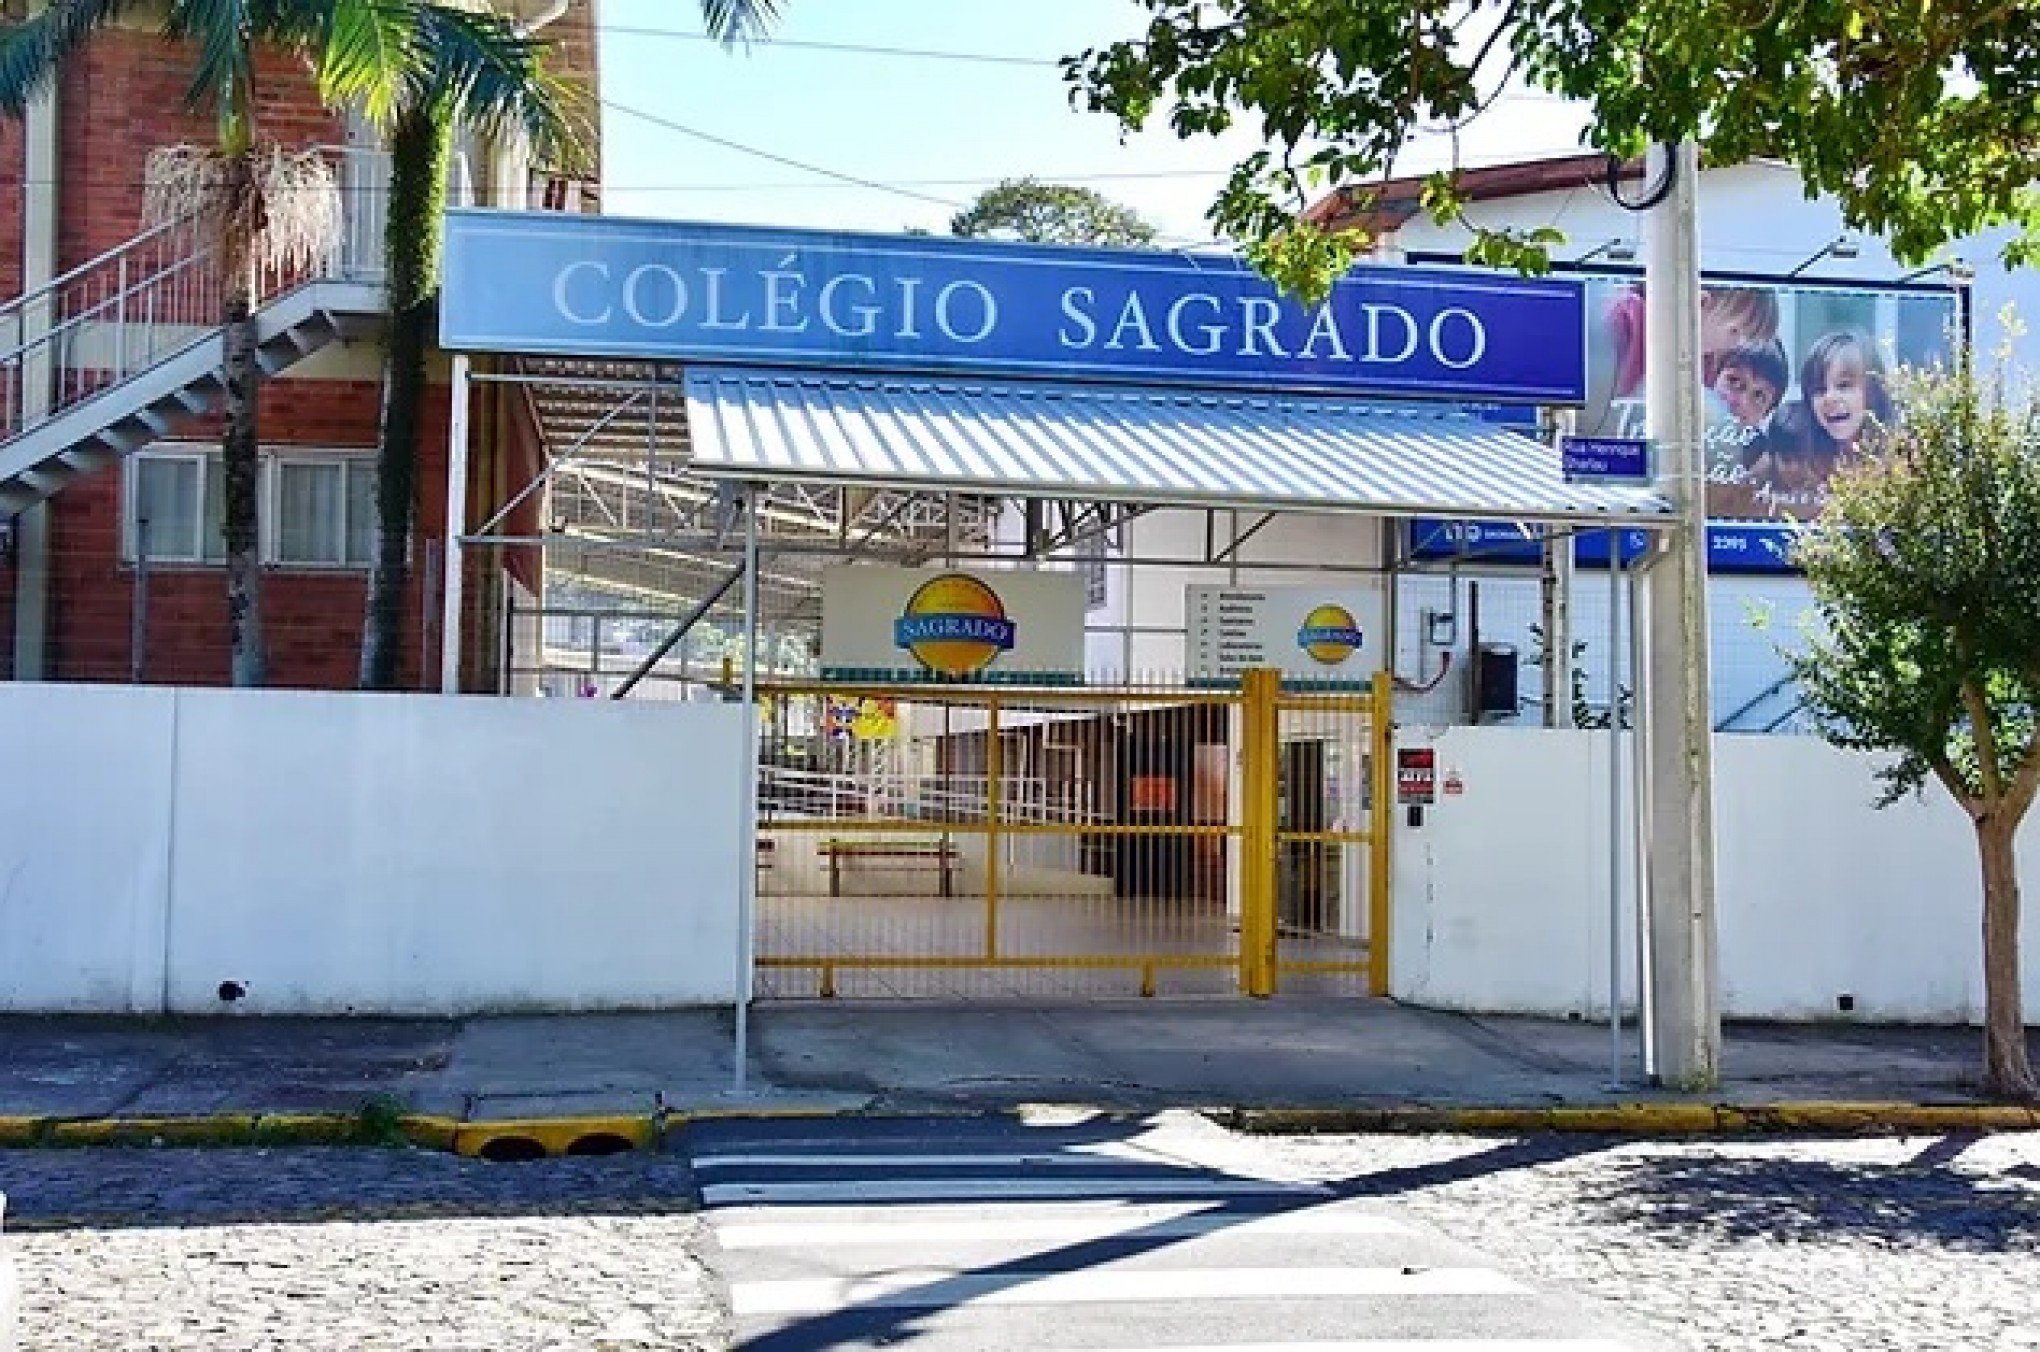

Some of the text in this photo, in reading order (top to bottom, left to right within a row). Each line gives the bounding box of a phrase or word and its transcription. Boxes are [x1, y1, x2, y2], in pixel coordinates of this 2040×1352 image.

[553, 254, 1487, 369] COLÉGIO SAGRADO
[902, 618, 1009, 641] SAGRADO
